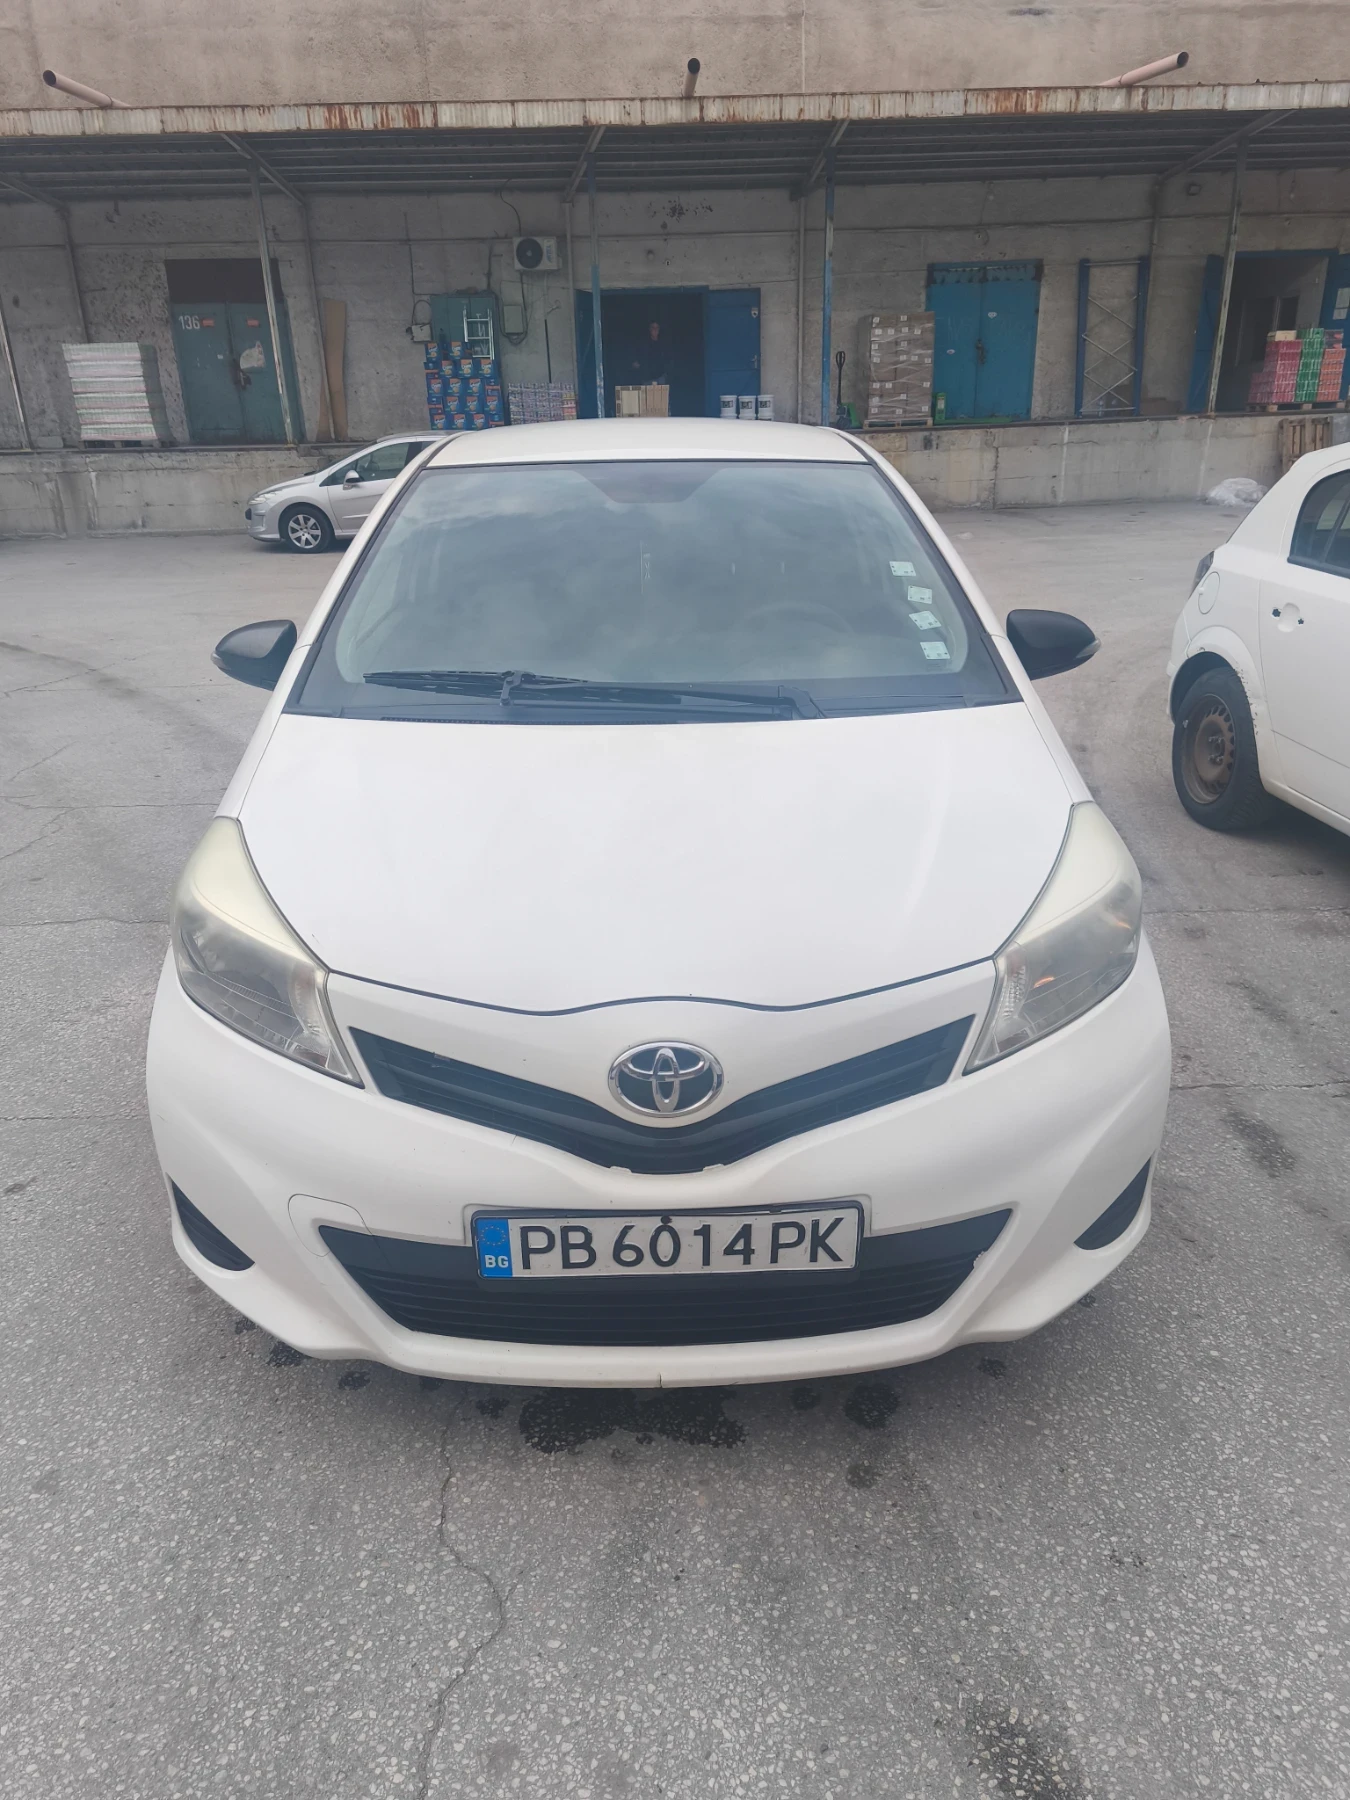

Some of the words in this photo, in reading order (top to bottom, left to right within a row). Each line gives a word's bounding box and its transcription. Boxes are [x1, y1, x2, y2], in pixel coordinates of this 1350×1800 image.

[178, 315, 200, 330] 136
[519, 1225, 597, 1270] PB
[613, 1224, 755, 1267] 6014
[770, 1216, 844, 1264] PK
[485, 1255, 509, 1268] BG
